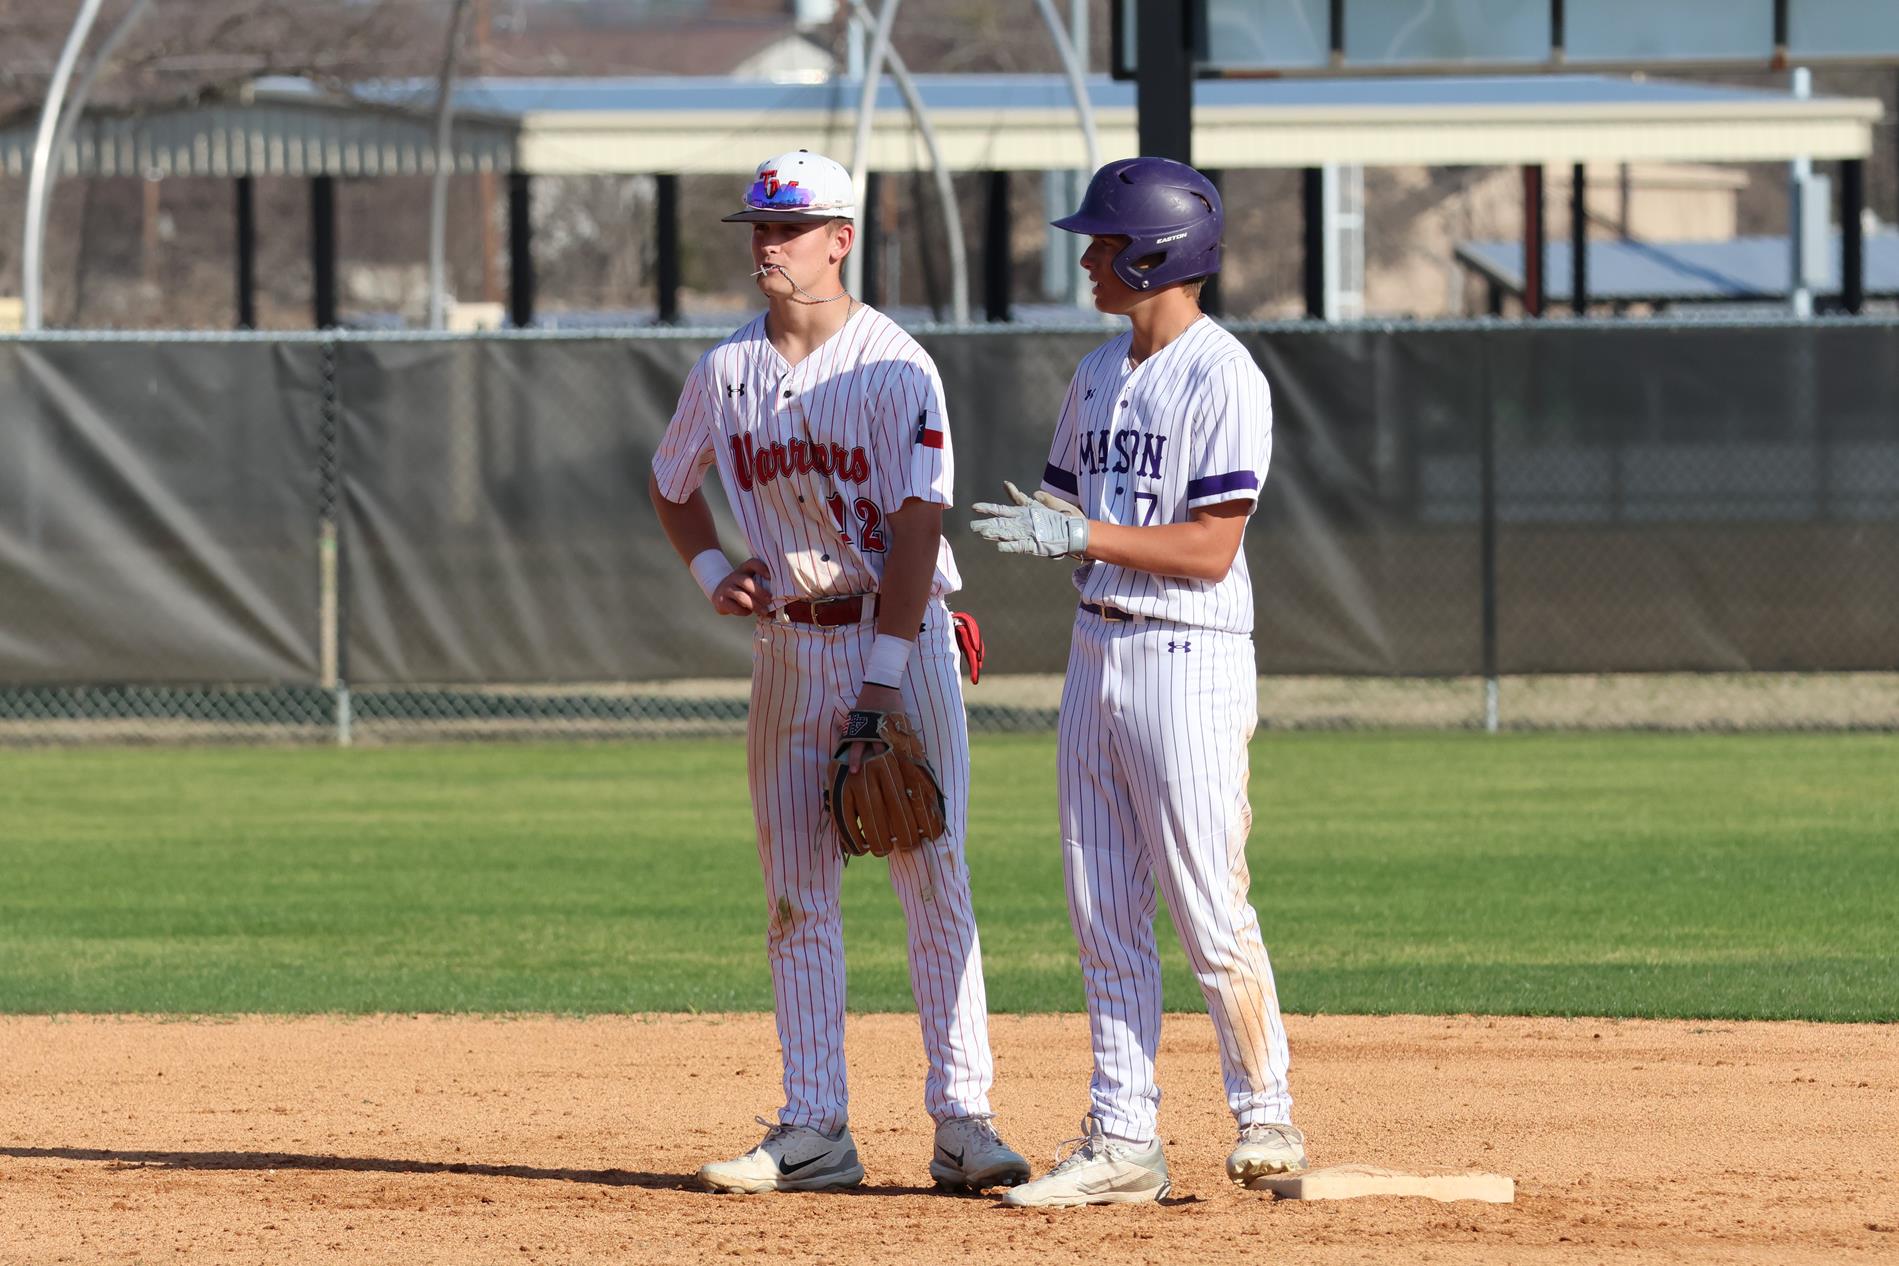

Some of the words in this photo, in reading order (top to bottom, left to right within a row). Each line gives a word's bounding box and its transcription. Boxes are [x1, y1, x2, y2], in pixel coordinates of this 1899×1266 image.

[1156, 232, 1188, 244] EASTON
[826, 492, 887, 553] 12
[1134, 491, 1158, 527] 7
